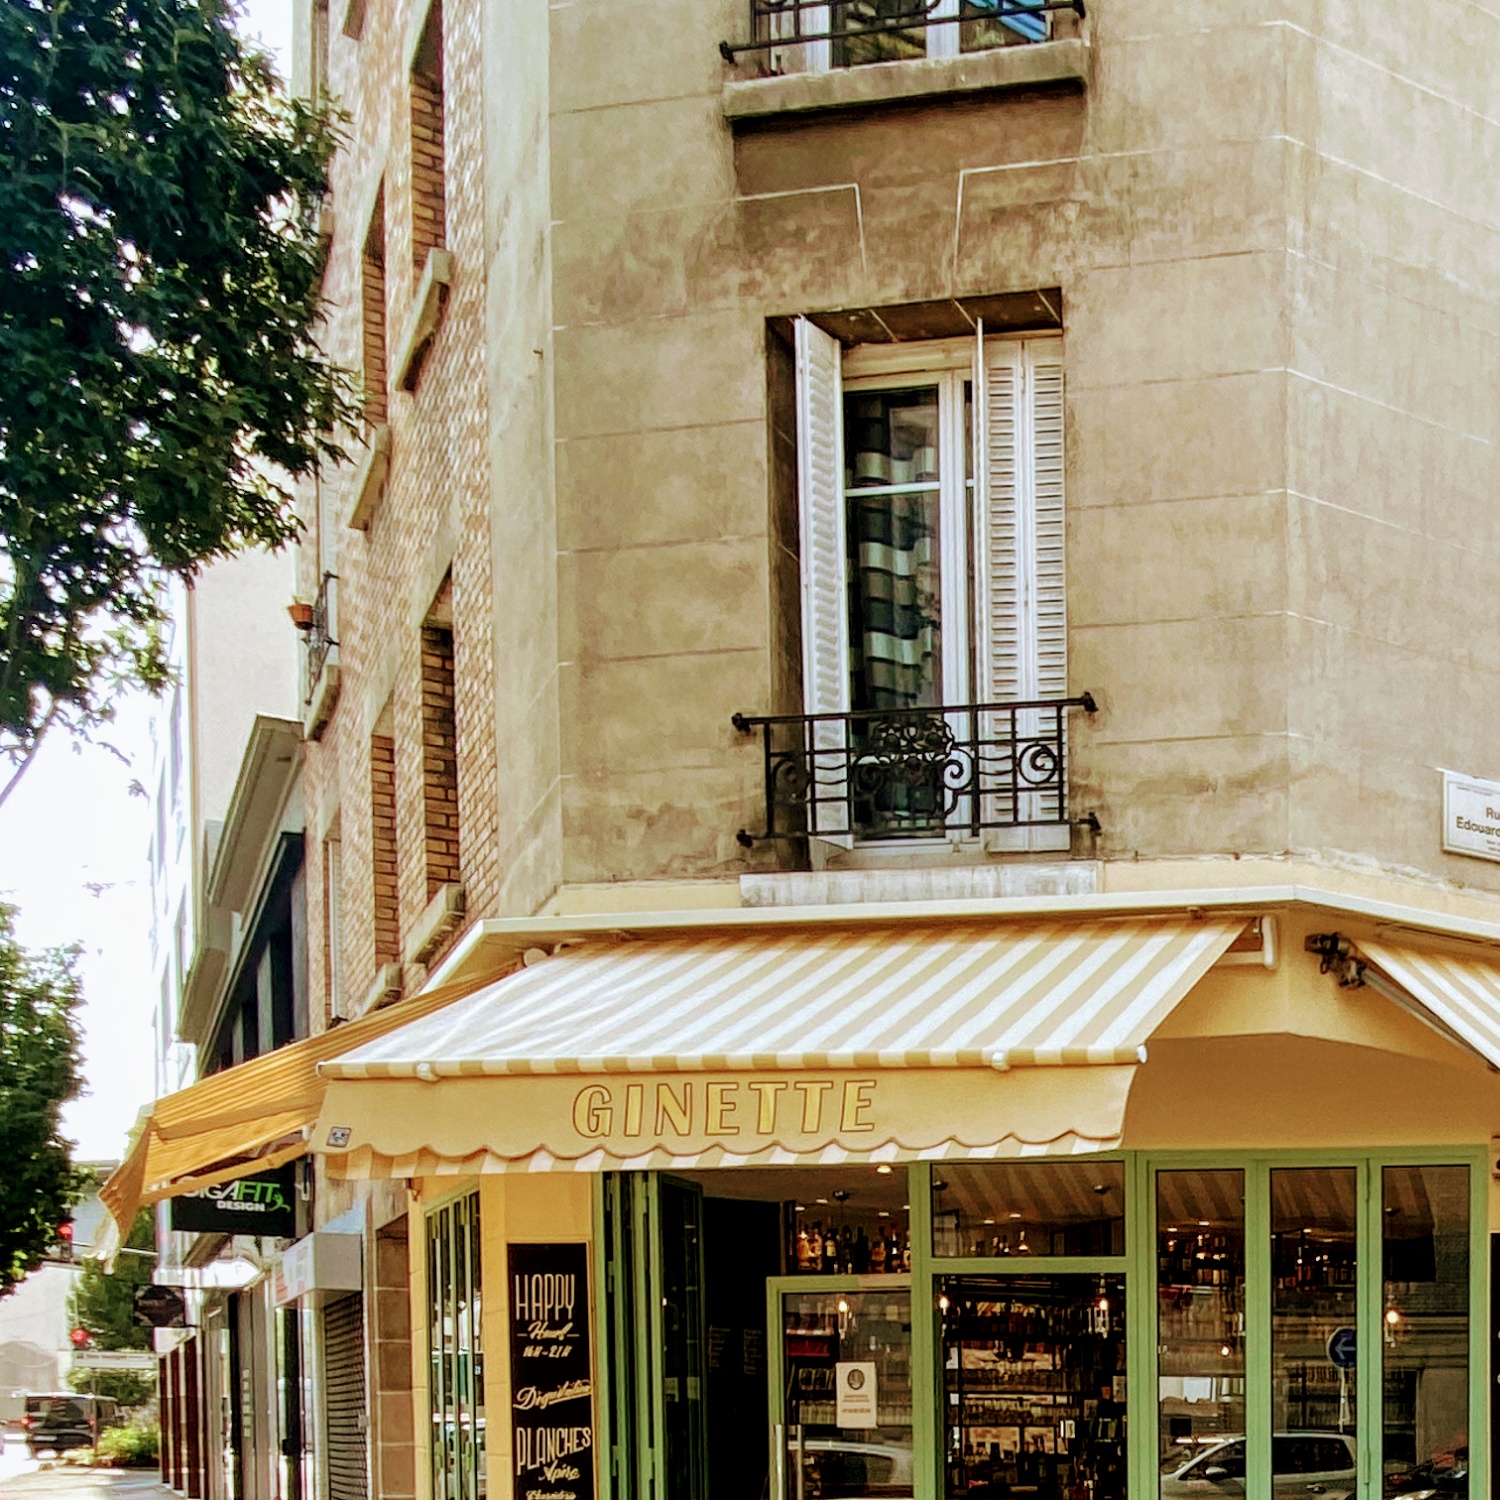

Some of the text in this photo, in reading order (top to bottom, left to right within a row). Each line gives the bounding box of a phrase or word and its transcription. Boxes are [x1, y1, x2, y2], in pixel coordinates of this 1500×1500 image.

[572, 1079, 877, 1139] GINETTE
[216, 1200, 266, 1212] DESIGN
[515, 1273, 575, 1321] HAPPY
[516, 1427, 592, 1476] PLANCHES
